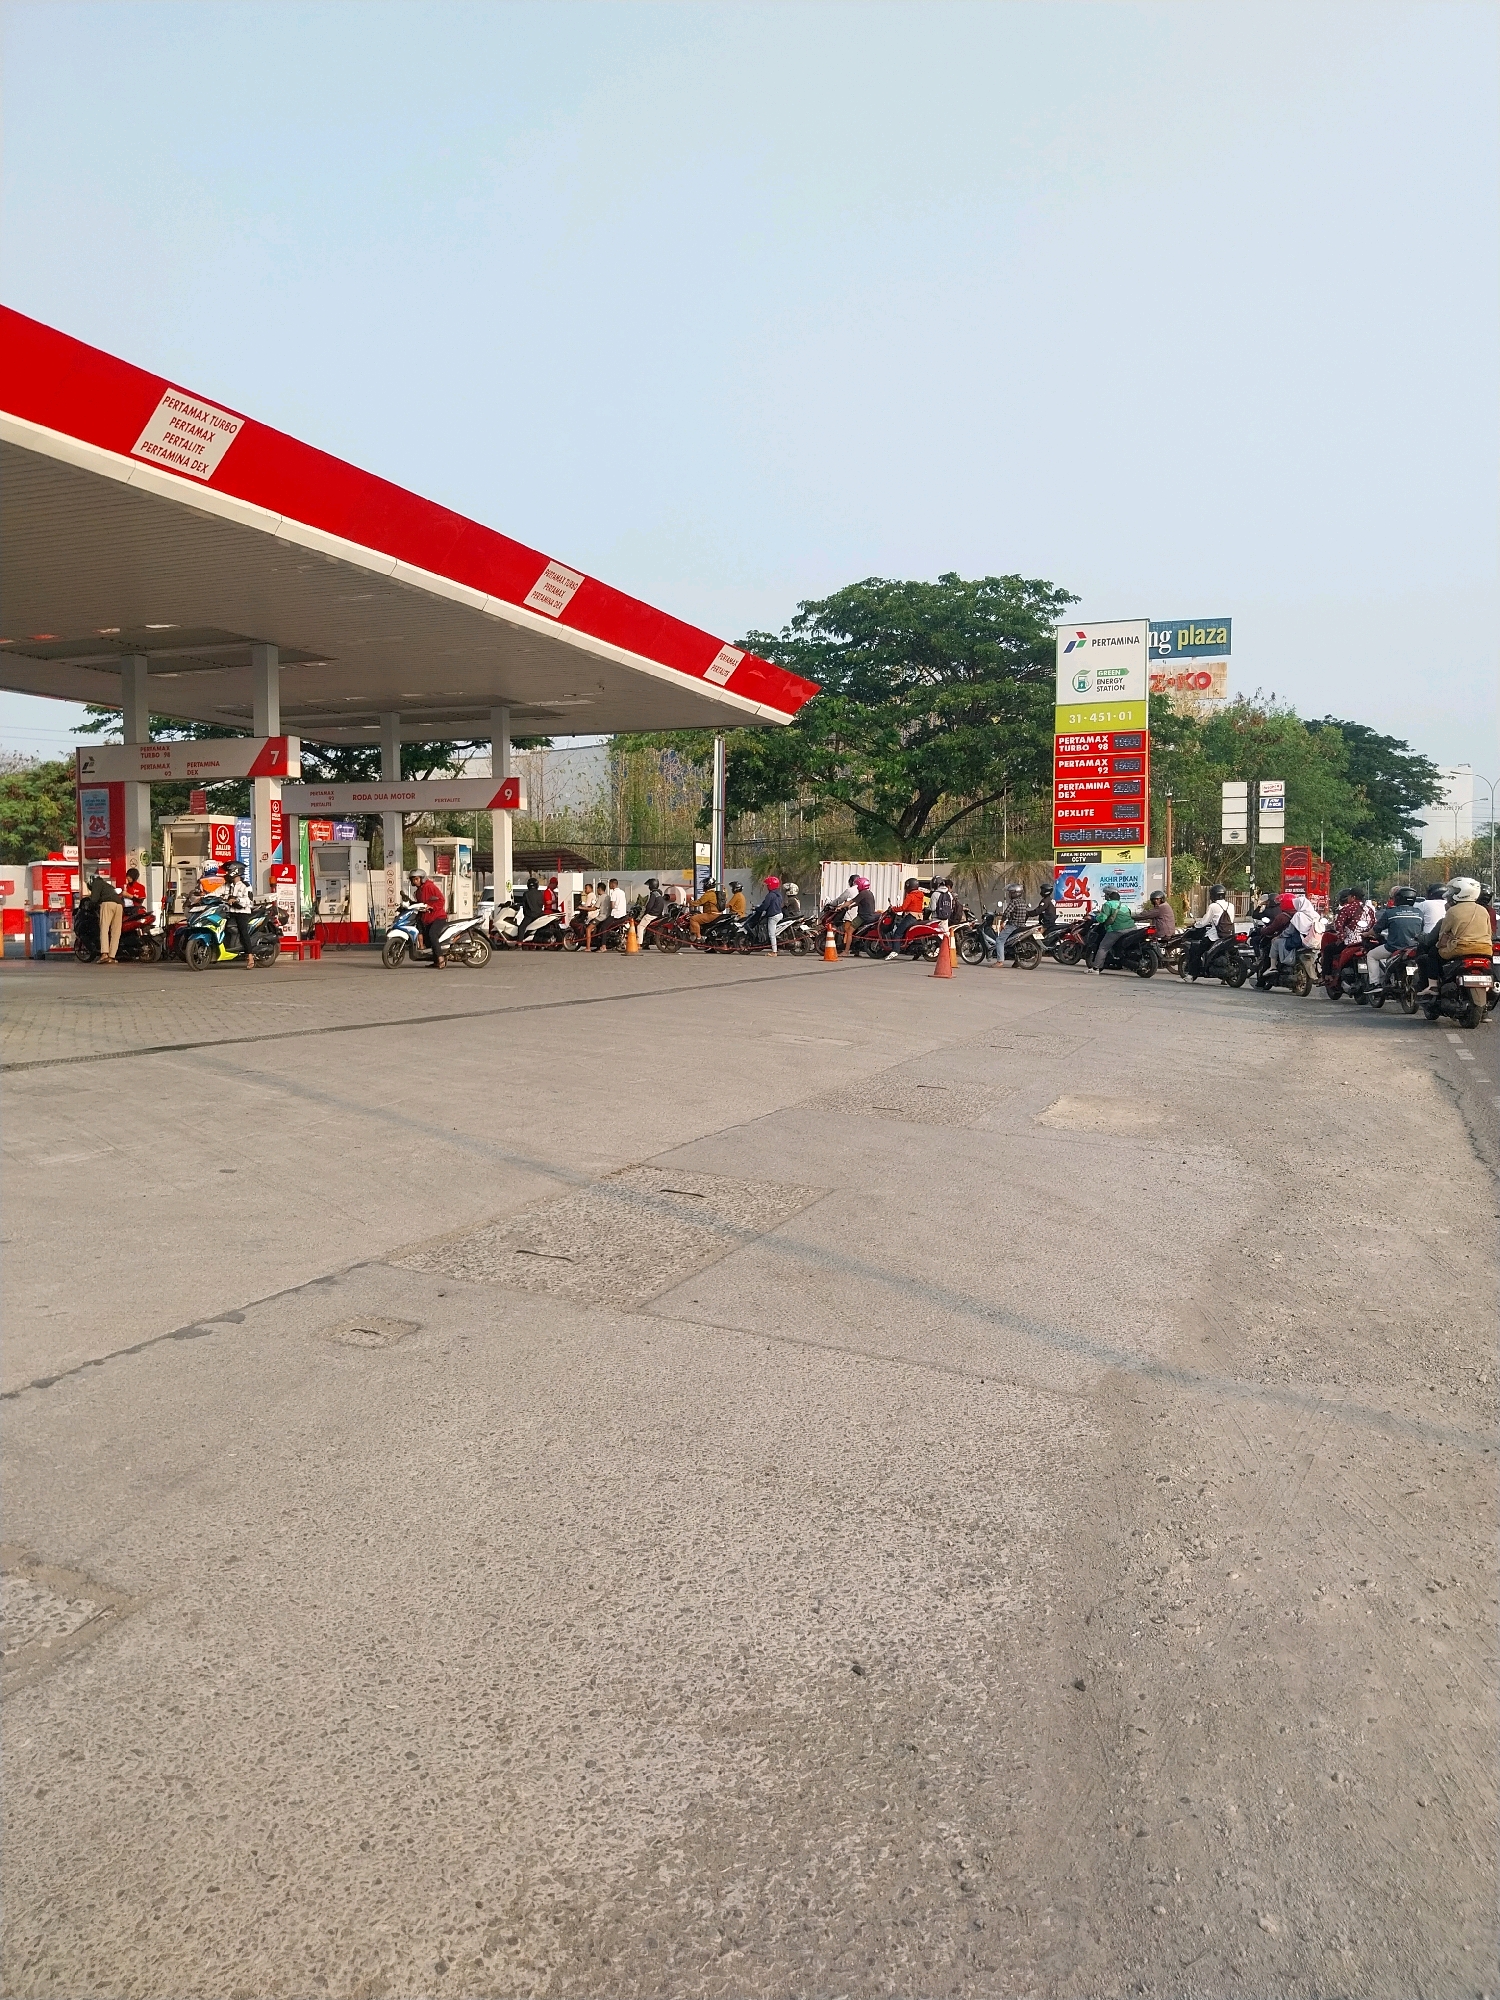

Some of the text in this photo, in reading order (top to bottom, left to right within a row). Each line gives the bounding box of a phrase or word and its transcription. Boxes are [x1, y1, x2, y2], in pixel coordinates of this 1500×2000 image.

[162, 396, 238, 434] PERTAMAX TURBO
[169, 417, 216, 443] PERTAMAX
[162, 432, 206, 455] PERTALITE
[140, 441, 210, 474] PERTAMINA DEX
[544, 569, 579, 590] PERTAMAX TURBO
[543, 582, 566, 598] PERTAMAX
[531, 591, 564, 610] PERTAMINA DEX
[1091, 636, 1140, 648] PERTAMINA
[1177, 624, 1227, 651] plaza
[718, 652, 739, 667] PERTAMAX
[1097, 677, 1123, 685] ENERGY
[1097, 685, 1126, 693] STATION
[1058, 735, 1109, 745] PERTAMAX
[1059, 743, 1109, 752] TURBO 98
[186, 760, 221, 768] PERTAMINA
[270, 750, 280, 765] 7
[1058, 758, 1109, 768] PERTAMAX
[1097, 767, 1109, 775] 92
[1058, 781, 1111, 791] PERTAMINA
[390, 792, 416, 800] MOTOR
[504, 788, 513, 801] 9
[1058, 791, 1077, 799] DEX
[1057, 809, 1095, 818] DEXLITE
[1094, 827, 1134, 840] Produk
[1063, 875, 1091, 899] 2X
